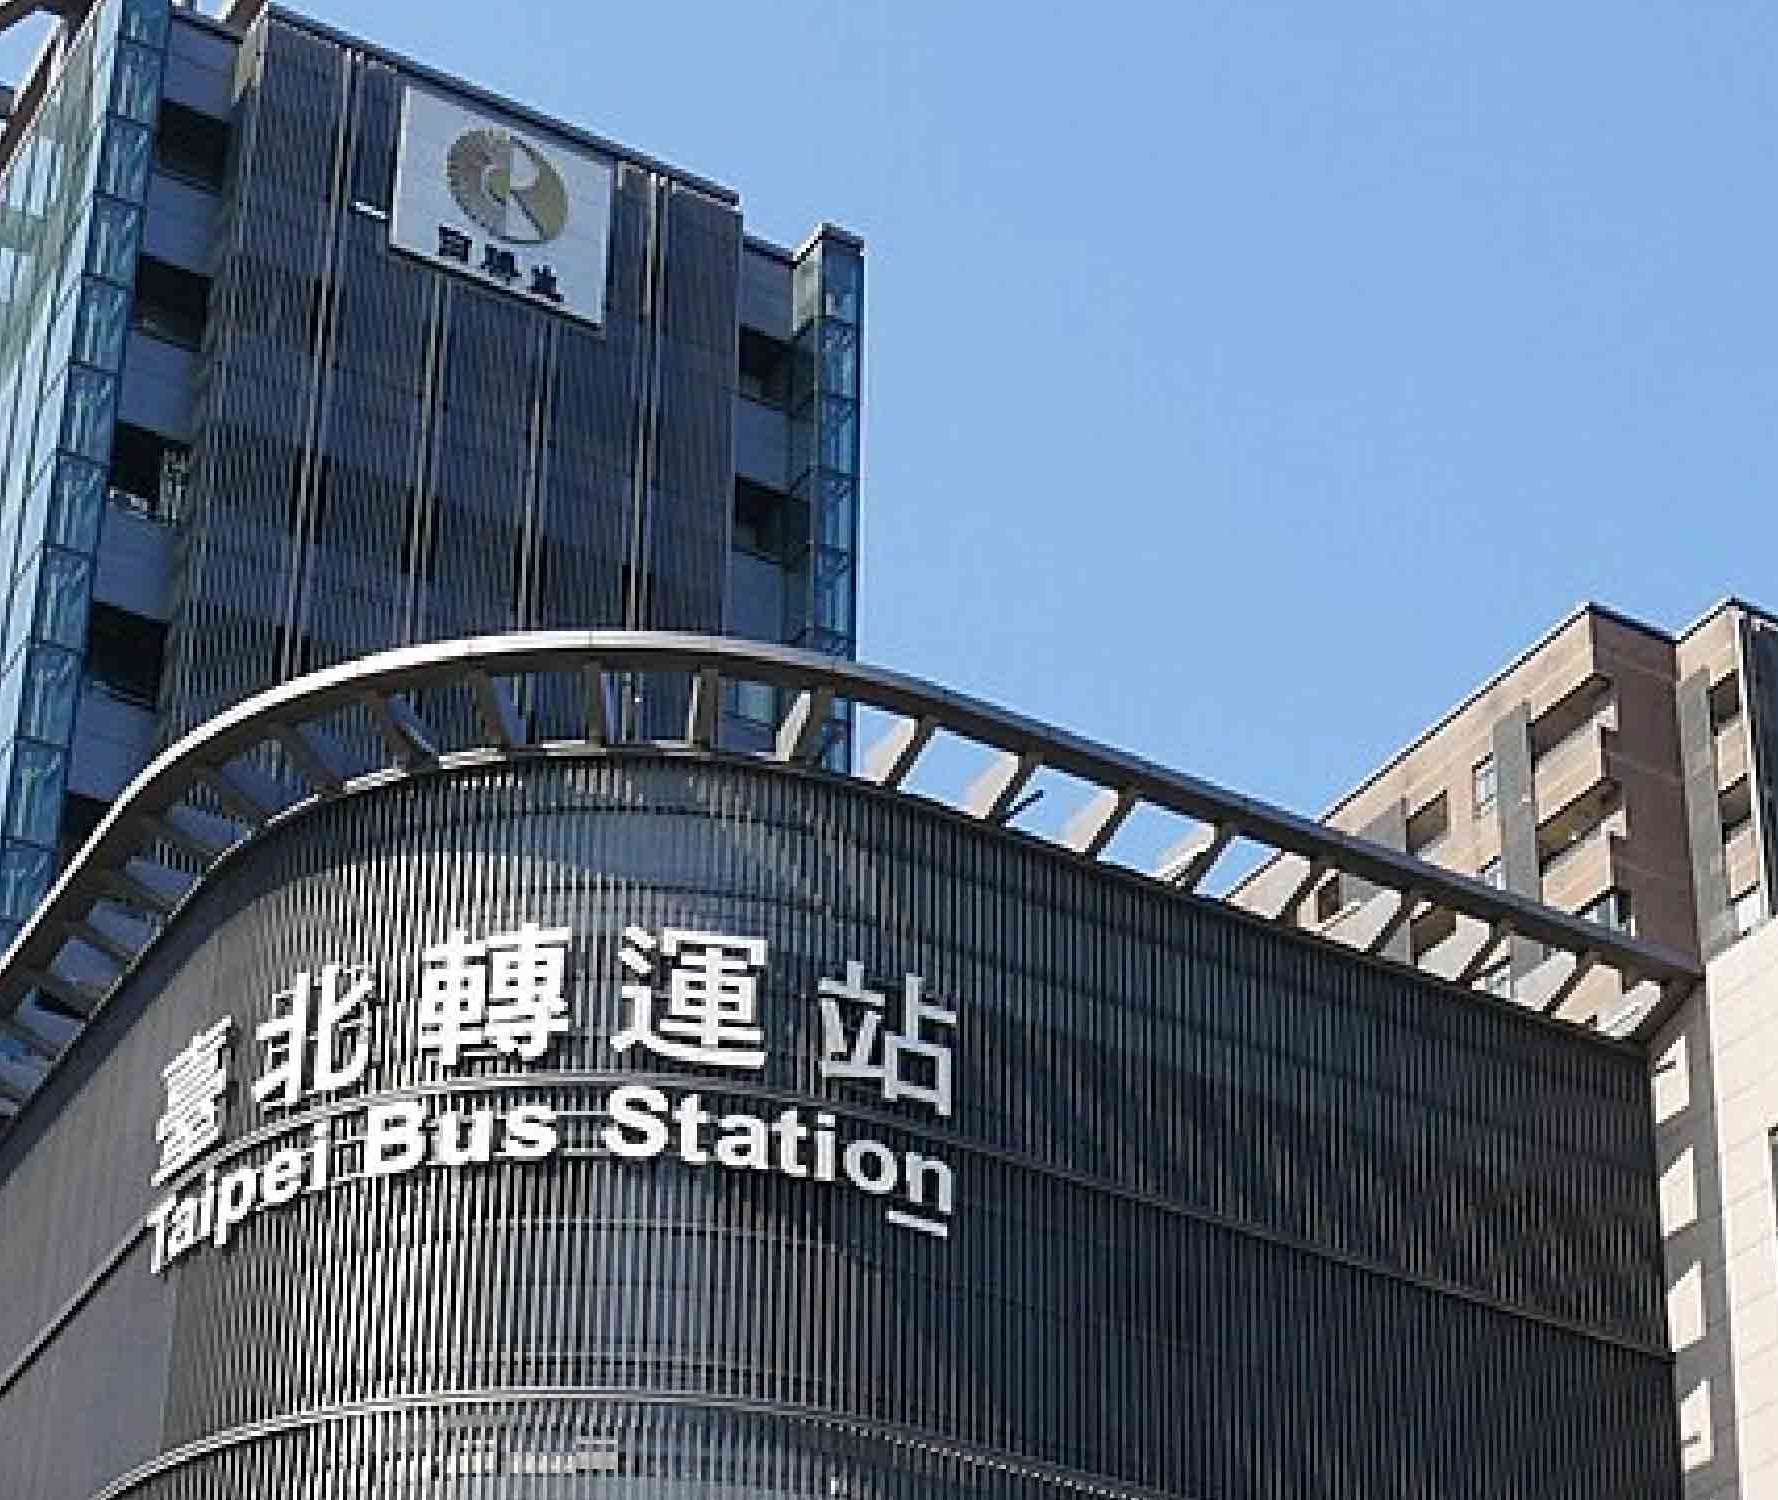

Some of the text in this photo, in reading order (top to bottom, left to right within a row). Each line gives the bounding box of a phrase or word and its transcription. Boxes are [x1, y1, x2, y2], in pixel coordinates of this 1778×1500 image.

[151, 922, 959, 1186] 臺北轉運站
[148, 1087, 955, 1274] Taipei Bus Station
